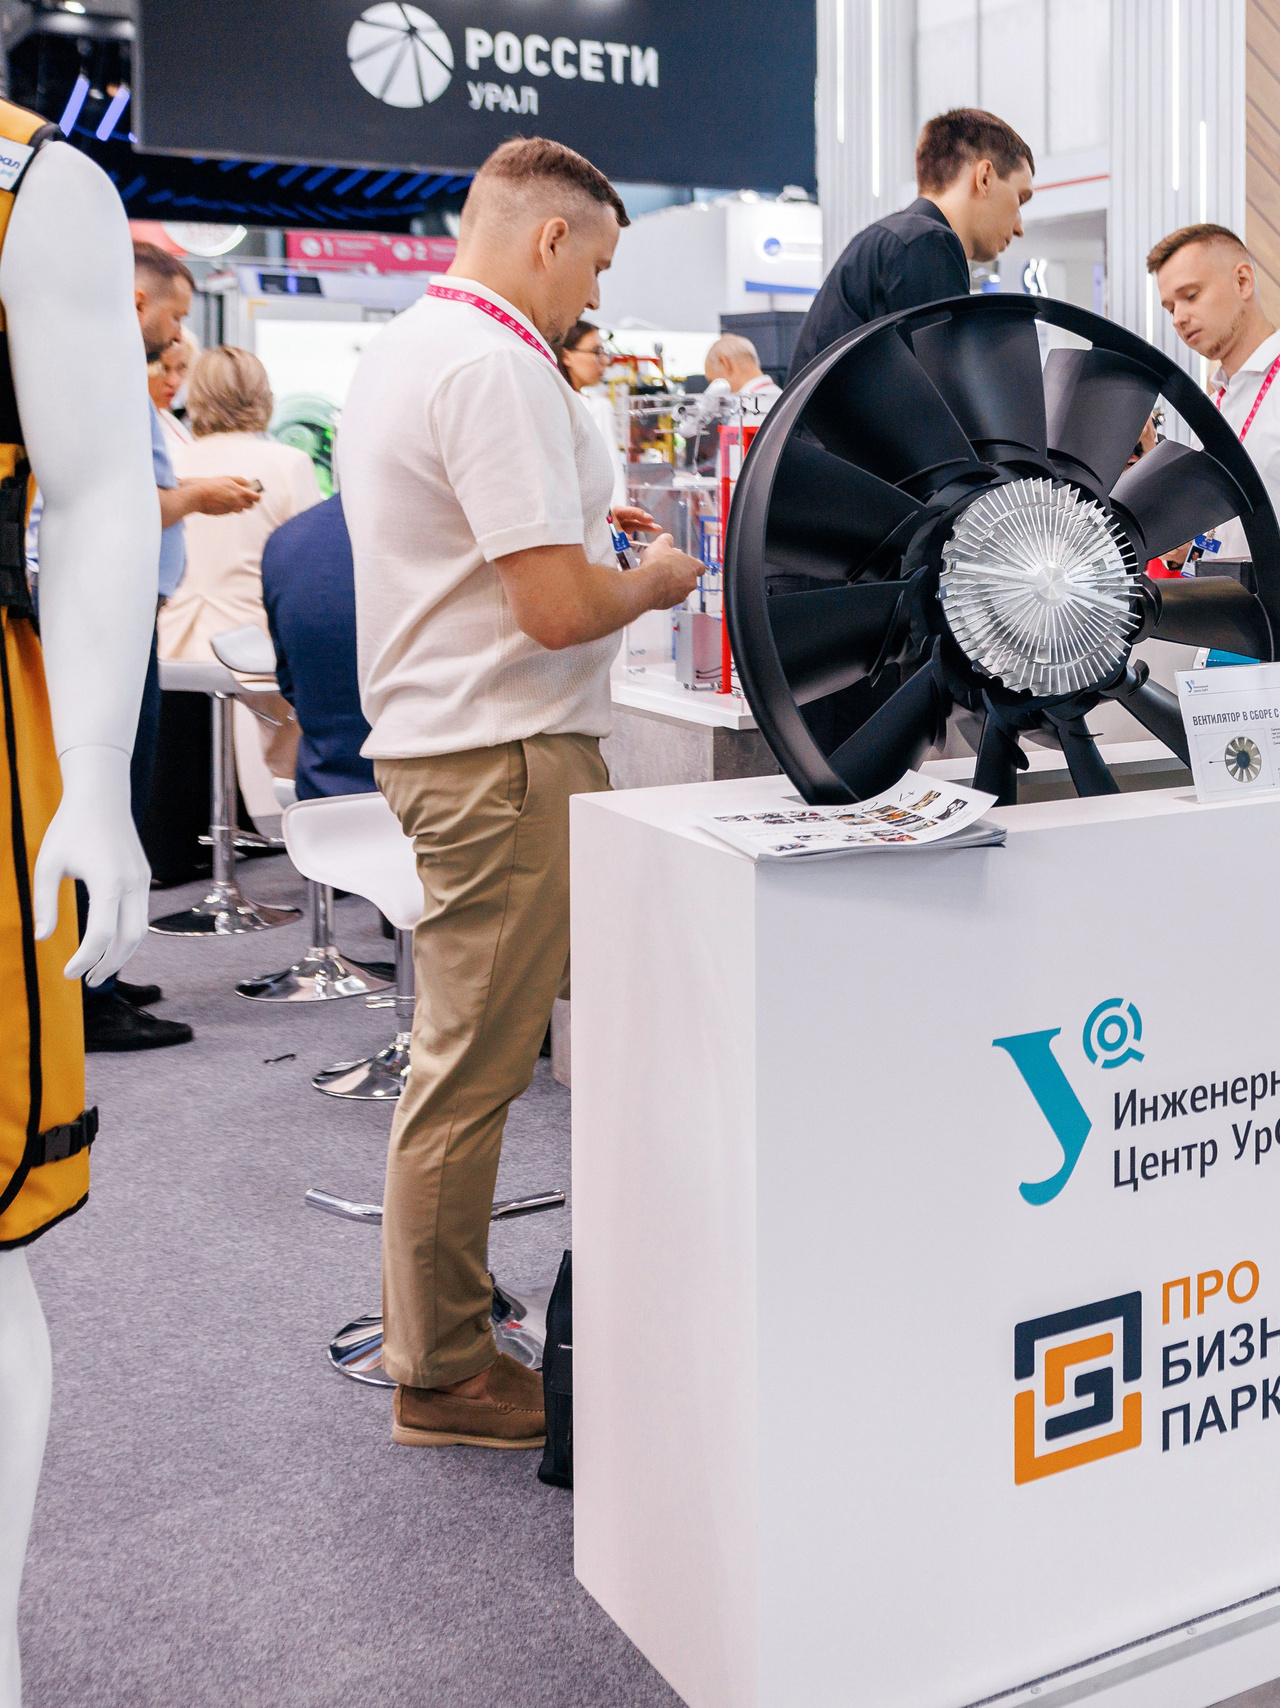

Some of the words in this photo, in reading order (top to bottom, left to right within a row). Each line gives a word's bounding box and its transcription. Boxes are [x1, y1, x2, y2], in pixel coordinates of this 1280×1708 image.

[465, 27, 659, 88] РОССЕТИ
[466, 80, 539, 116] УРАЛ
[1192, 711, 1241, 726] ВЕНТИЛЯТОР
[1242, 711, 1249, 721] В
[1249, 709, 1273, 721] СБОРЕ
[1273, 708, 1280, 718] С
[1112, 1137, 1219, 1193] Центр
[1161, 1259, 1261, 1326] ПРО
